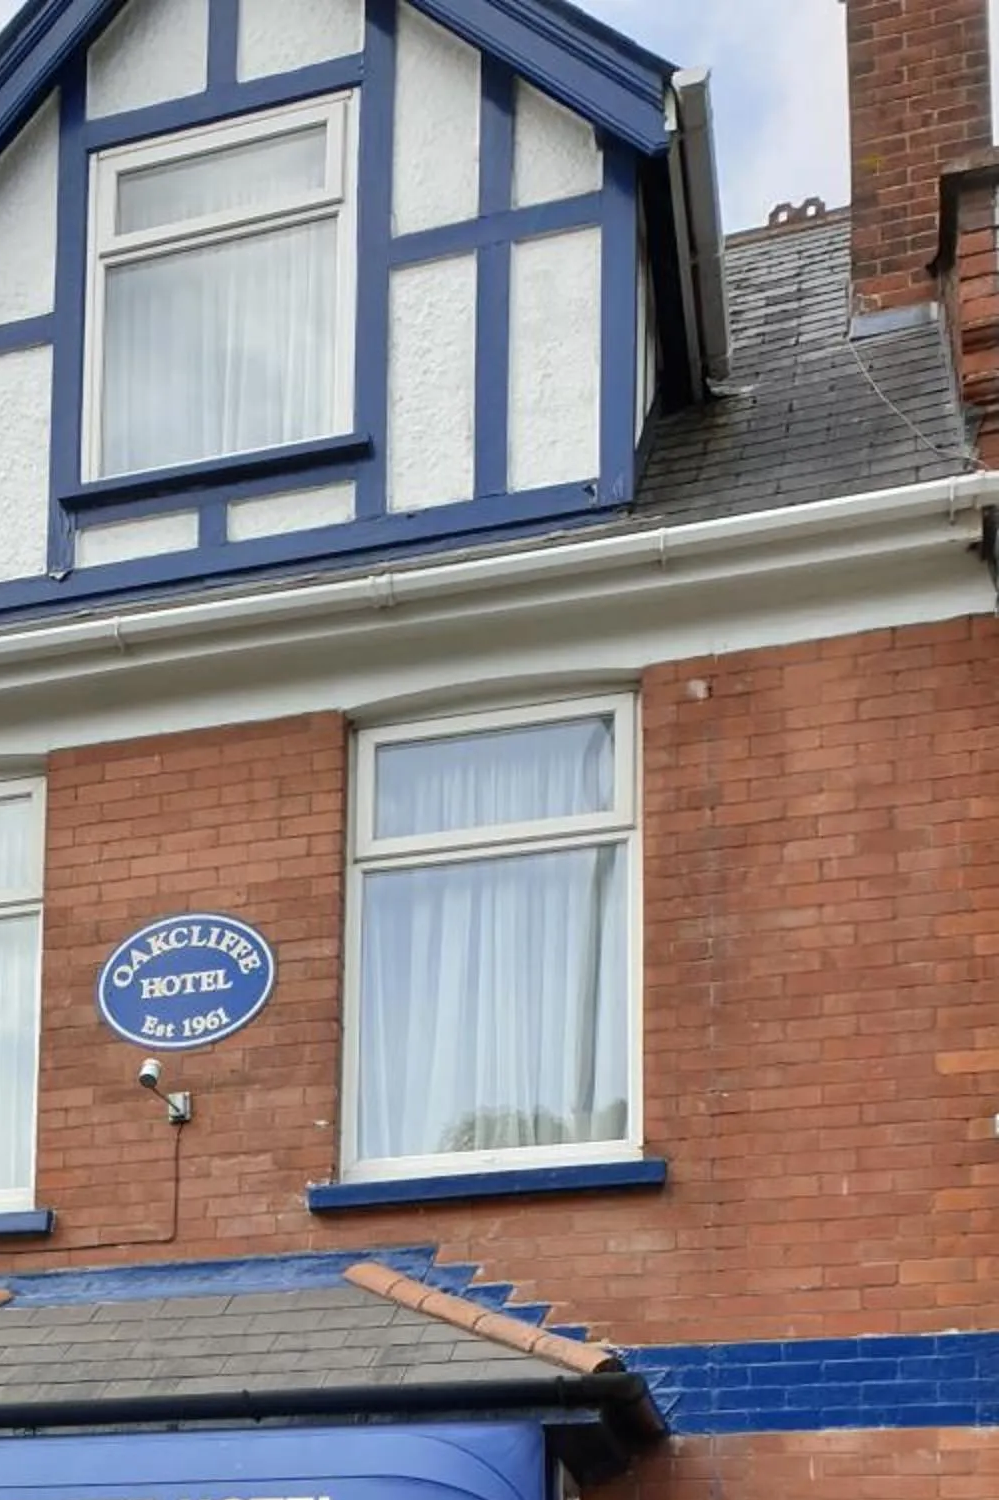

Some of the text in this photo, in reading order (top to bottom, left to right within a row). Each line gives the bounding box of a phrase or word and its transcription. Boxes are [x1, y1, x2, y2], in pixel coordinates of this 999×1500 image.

[112, 925, 261, 987] OAKCLIFFE
[140, 969, 233, 999] HOTEL
[141, 1008, 231, 1037] Est 1961
